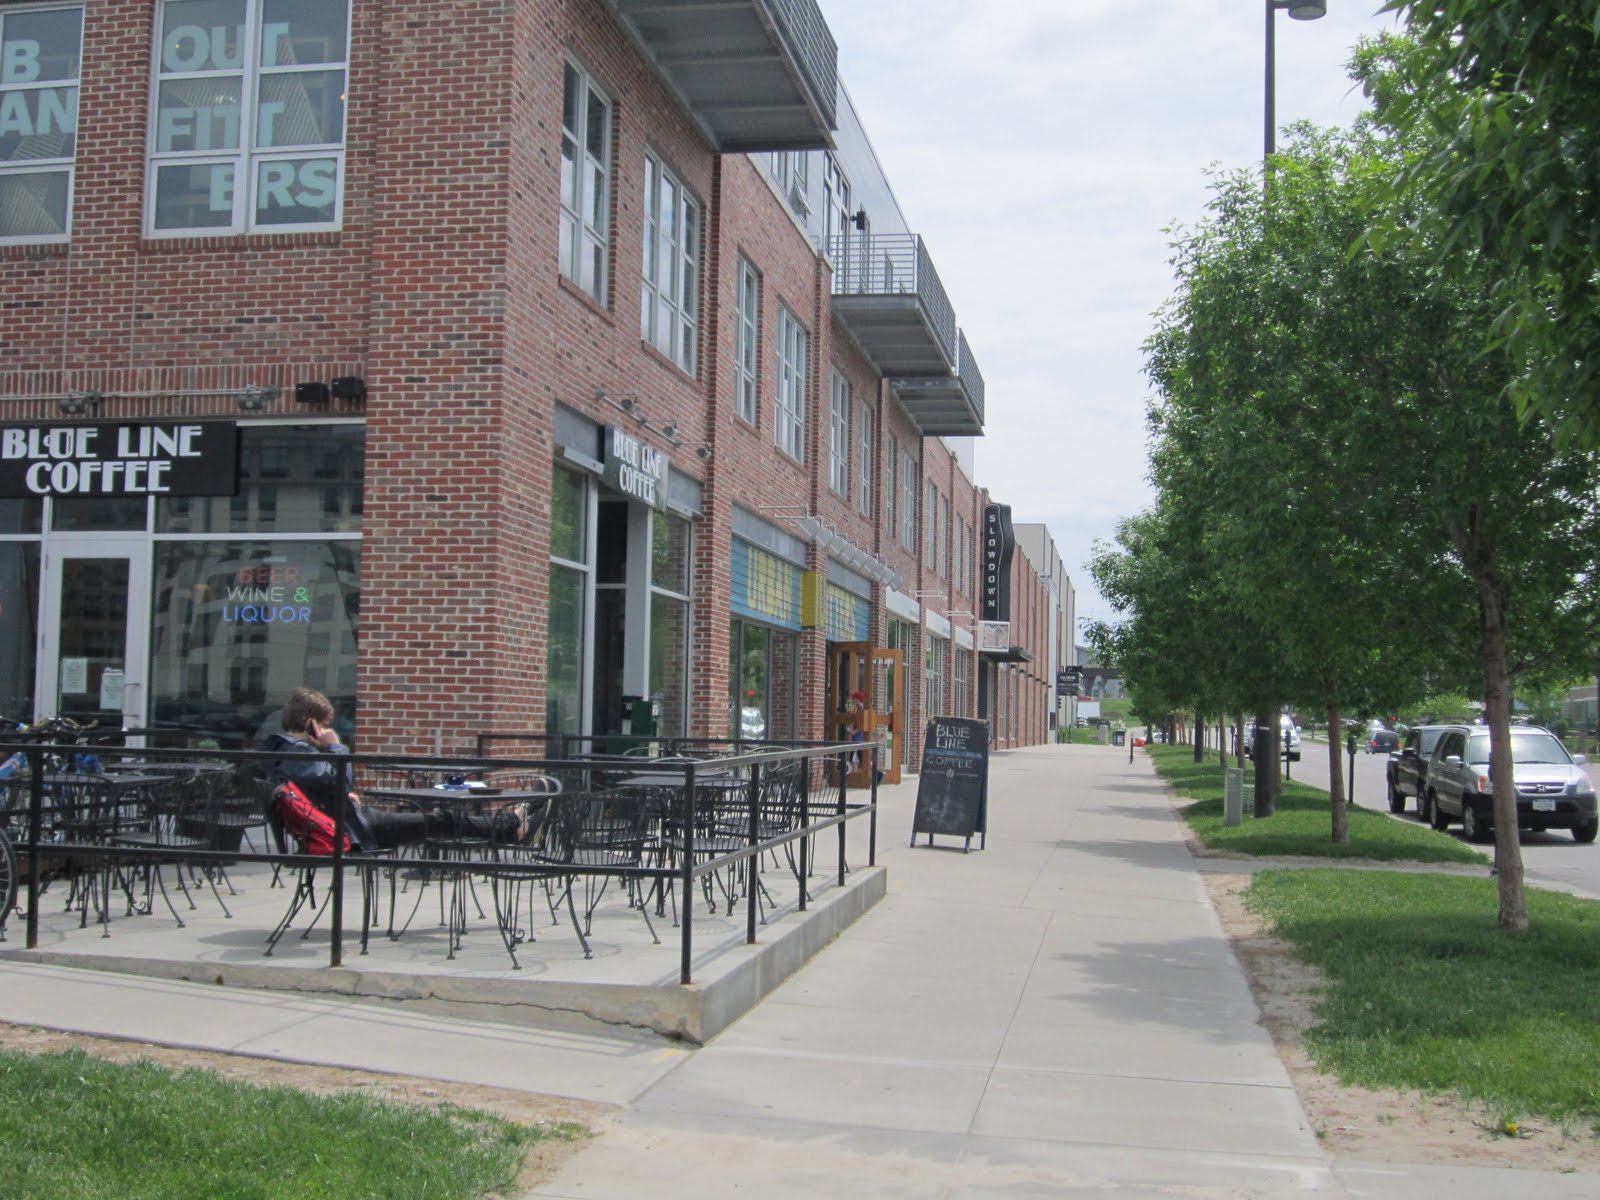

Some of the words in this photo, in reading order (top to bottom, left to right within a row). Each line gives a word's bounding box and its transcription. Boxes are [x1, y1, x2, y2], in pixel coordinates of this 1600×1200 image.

[5, 39, 41, 83] B
[163, 23, 289, 72] OUT
[0, 86, 77, 136] AN
[158, 101, 285, 152] FITT
[209, 160, 337, 212] ERS
[2, 427, 98, 459] BLUE
[117, 426, 203, 458] LINE
[613, 431, 638, 466] BLUE
[641, 445, 662, 479] LINE
[26, 461, 172, 493] COFFEE
[619, 464, 656, 504] COFFEE
[240, 567, 298, 584] BEER
[987, 514, 996, 608] SLOWDOWN
[227, 586, 286, 602] WINE
[294, 586, 309, 602] &
[223, 605, 312, 623] LIQUOR
[936, 724, 970, 739] BLUE
[936, 738, 966, 750] LINE
[926, 756, 973, 768] COFFEE
